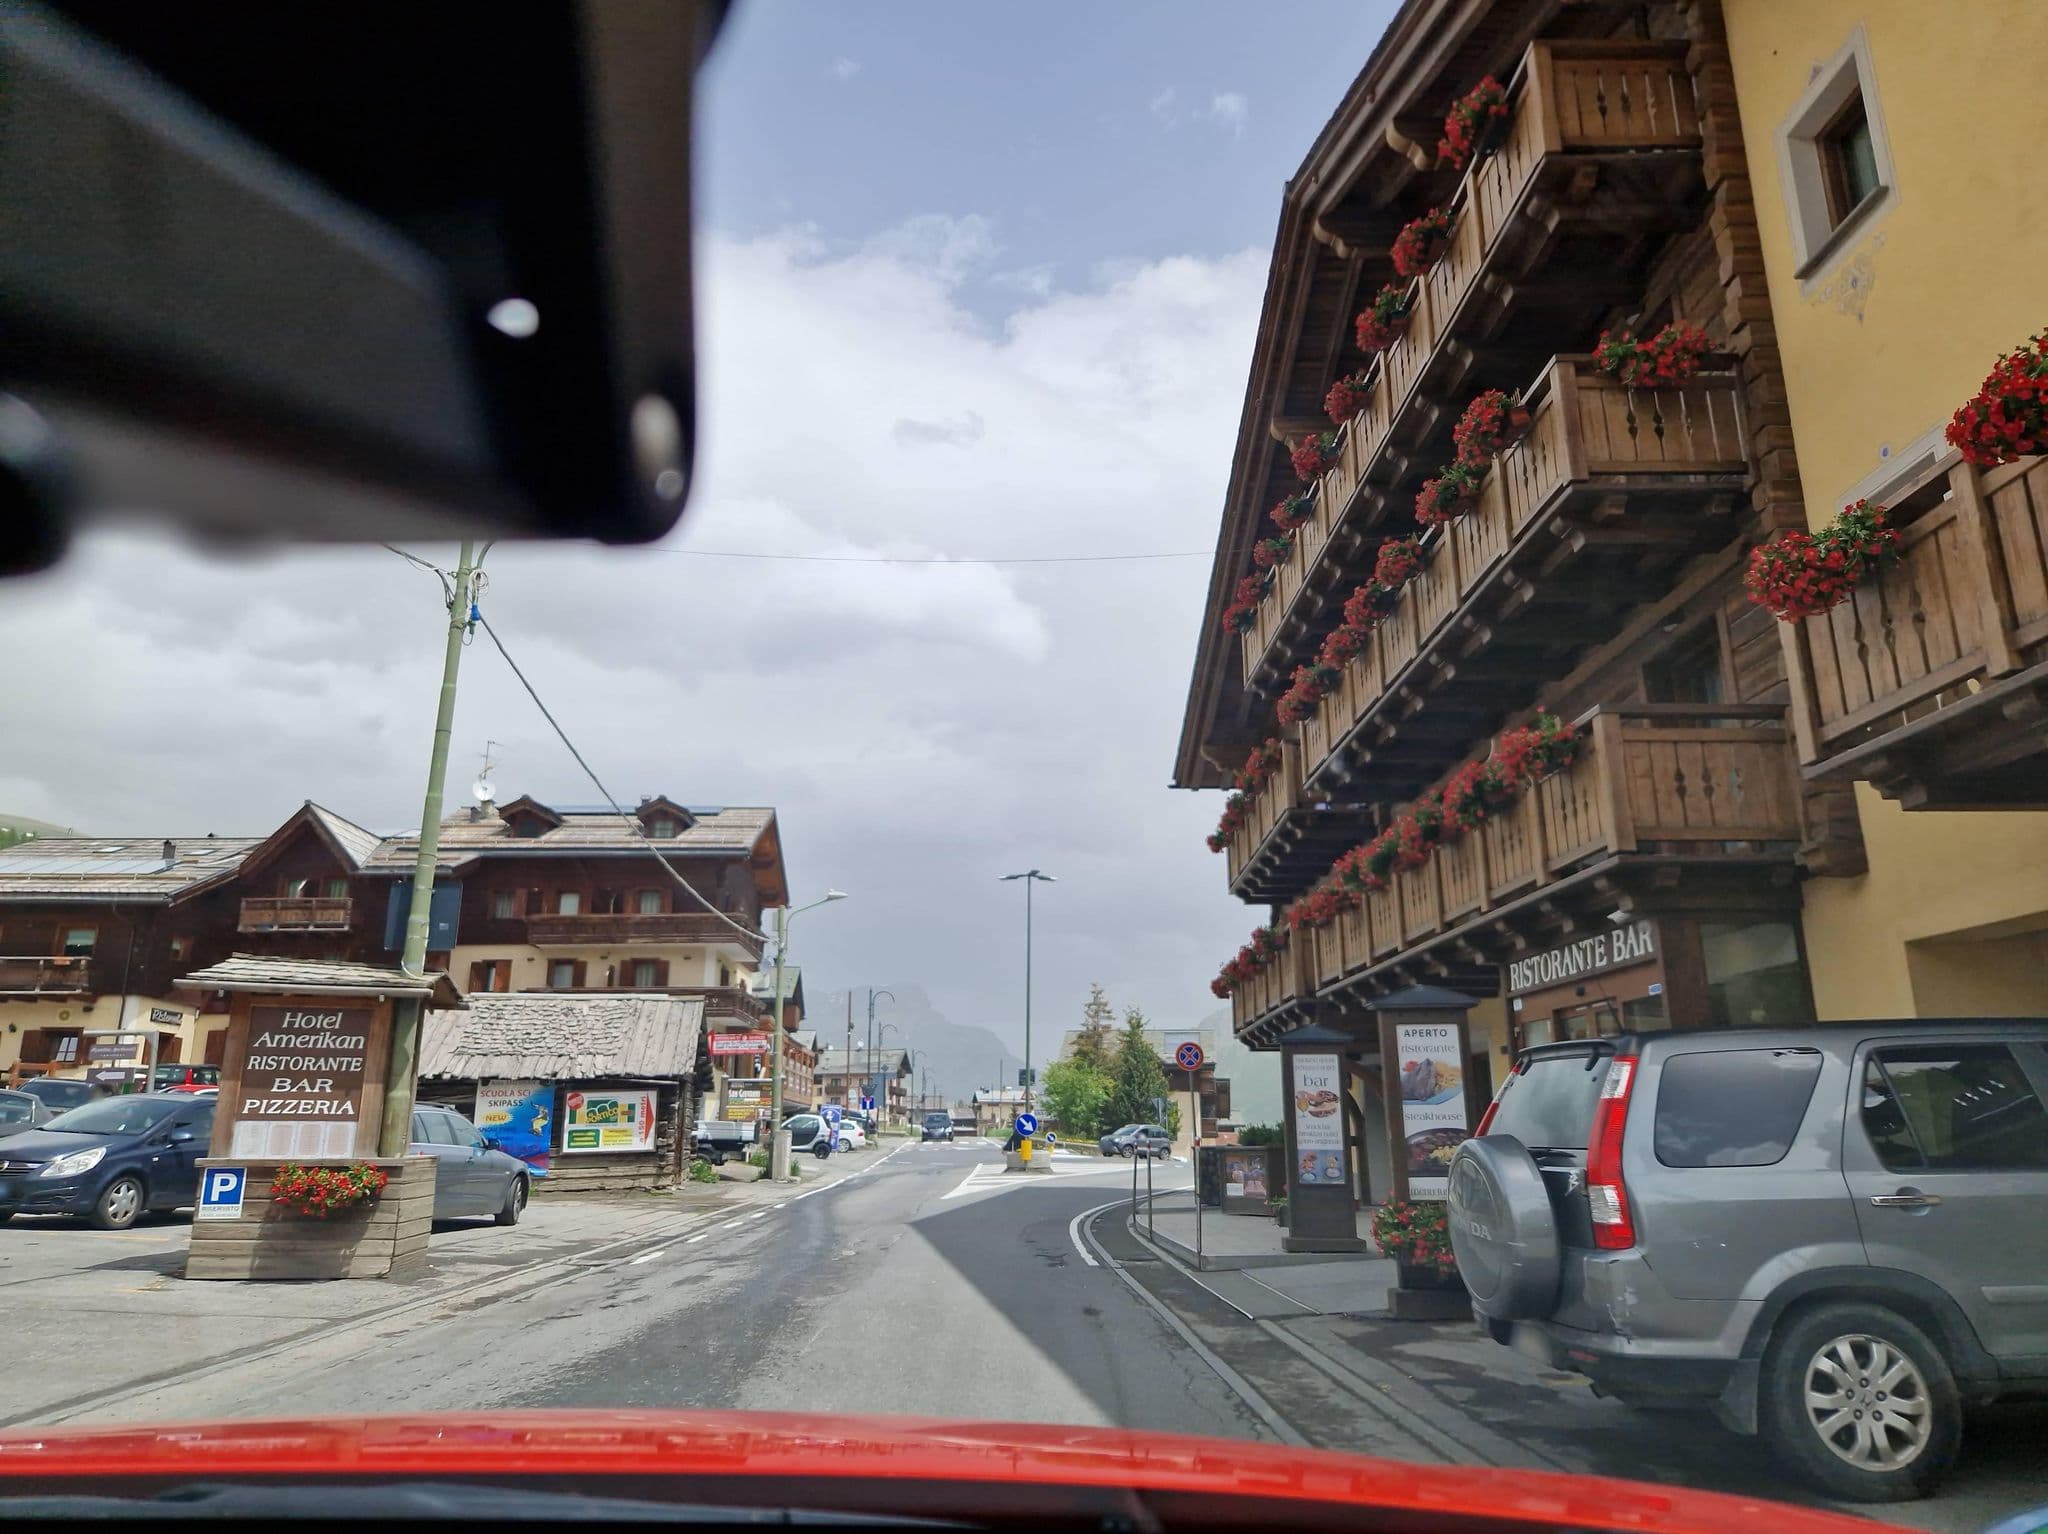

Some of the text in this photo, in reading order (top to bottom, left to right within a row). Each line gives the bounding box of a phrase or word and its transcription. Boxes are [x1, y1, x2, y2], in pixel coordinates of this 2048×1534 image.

[1510, 919, 1654, 991] RISTORANTE BAR
[282, 1011, 343, 1029] Hotel
[1403, 1028, 1448, 1037] APERTO
[253, 1031, 365, 1049] Amerikan
[1401, 1044, 1456, 1054] ristorante
[247, 1055, 363, 1072] RISTORANTE
[270, 1077, 334, 1093] BAR
[1303, 1074, 1328, 1087] bar
[480, 1089, 531, 1098] SCUOLA SCI
[241, 1100, 355, 1115] PIZZERIA
[488, 1099, 523, 1107] SKIPASS
[485, 1114, 507, 1122] NEW
[1404, 1112, 1463, 1121] steakhouse
[211, 1173, 237, 1201] P
